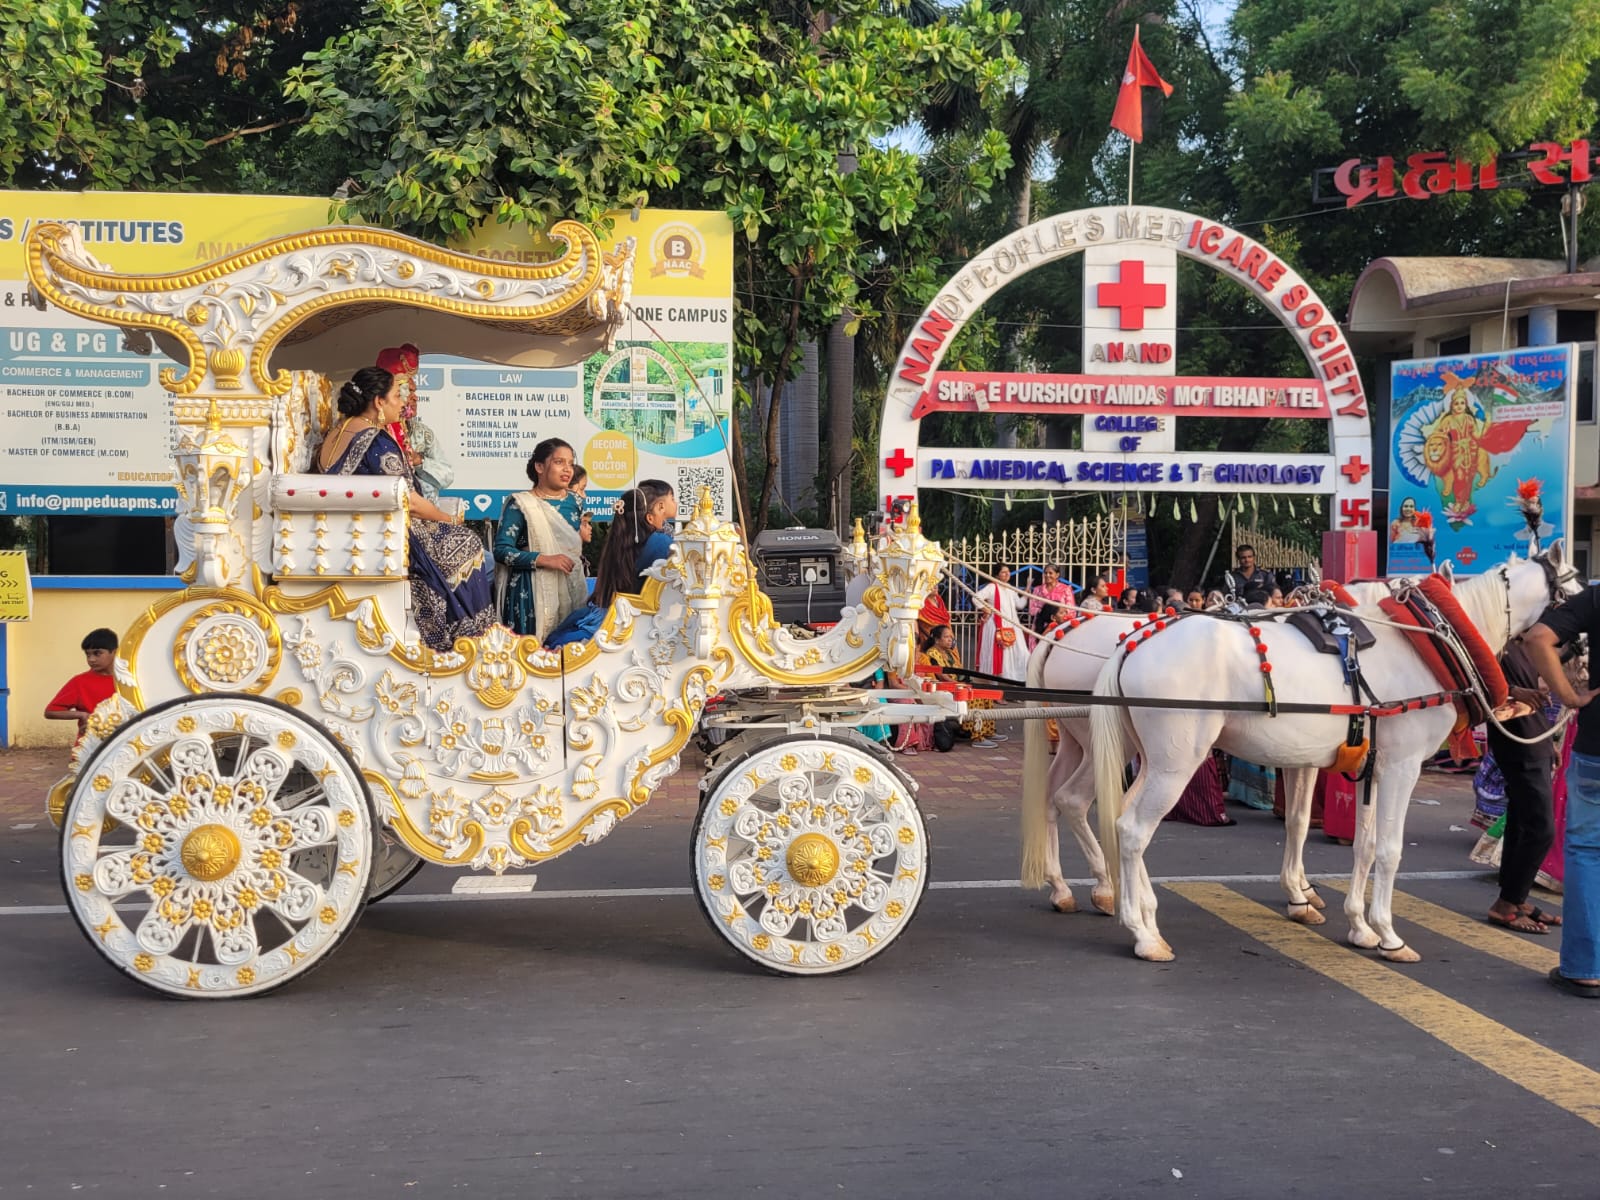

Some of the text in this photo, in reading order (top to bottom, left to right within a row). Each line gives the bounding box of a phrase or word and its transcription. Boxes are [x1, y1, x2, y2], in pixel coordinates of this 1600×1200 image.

[38, 220, 183, 243] TITUTES
[671, 241, 685, 256] B
[663, 261, 692, 270] NAAC
[635, 307, 663, 321] ONE
[668, 308, 728, 323] CAMPUS
[956, 214, 1105, 303] PEOPLE'S
[1117, 211, 1287, 292] MEDICARE
[1281, 284, 1368, 418] SOCIETY
[9, 331, 41, 352] UG
[51, 332, 66, 353] &
[77, 333, 107, 353] PG
[1090, 342, 1172, 364] ANAND
[2, 367, 144, 379] COMMERCE & MANAGEMENT
[499, 374, 522, 383] LAW
[7, 389, 134, 399] BACHELOR OF COMMERCE (B.COM)
[465, 392, 569, 403] BACHELOR IN LAW (LLB)
[1266, 387, 1325, 408] PATEL
[7, 410, 148, 420] BACHELOR OF BUSINESS ADMINISTRATION
[465, 408, 571, 419] MASTER IN LAW (LLM)
[54, 423, 81, 432] (B.B.A)
[466, 421, 518, 429] CRIMINAL LAW
[1095, 415, 1165, 432] COLLEGE
[495, 431, 520, 439] RIGHTS
[522, 431, 537, 439] LAW
[503, 441, 518, 449] LAW
[592, 440, 627, 449] BECOME
[1119, 436, 1141, 453] OF
[8, 448, 129, 458] MASTER OF COMMERCE (M.COM)
[606, 452, 613, 460] A
[592, 461, 627, 470] DOCTOR
[1077, 461, 1163, 484] SCIENCE
[1169, 463, 1183, 482] &
[16, 493, 177, 510] info@pmpeduapms.or
[586, 496, 600, 504] OPP
